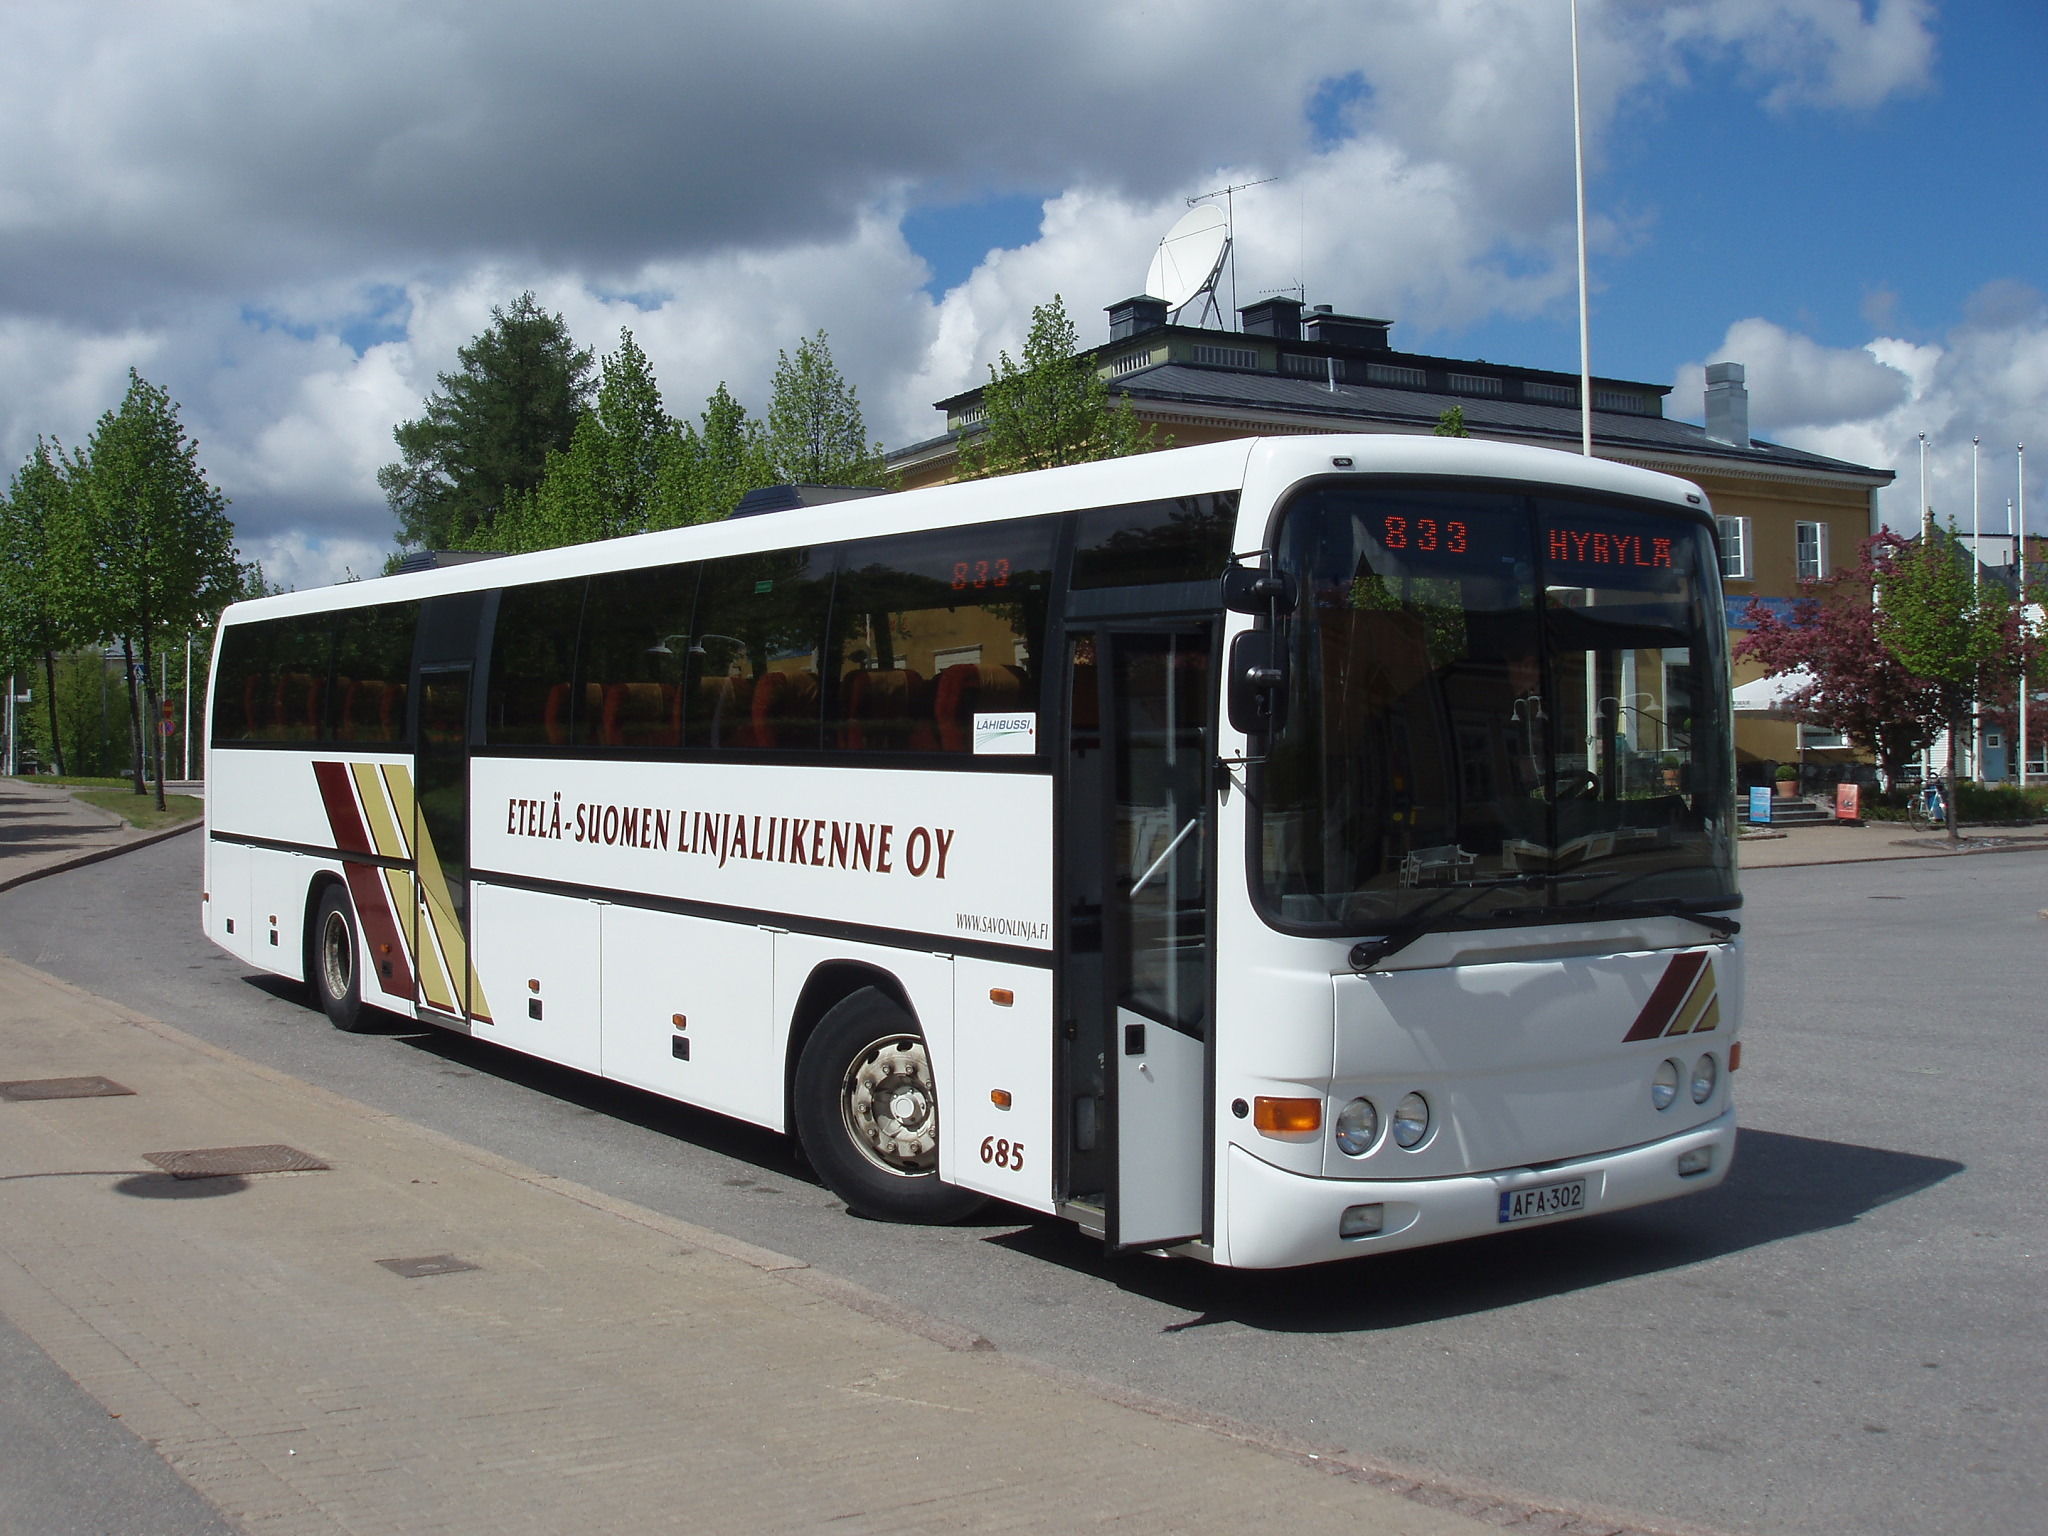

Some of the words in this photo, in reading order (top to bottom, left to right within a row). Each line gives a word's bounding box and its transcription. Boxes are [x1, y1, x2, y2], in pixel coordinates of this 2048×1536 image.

[1385, 516, 1467, 553] 833
[1549, 529, 1671, 567] HYRYLÄ
[952, 558, 1010, 590] 833
[976, 718, 1031, 731] LÄHIBUSSI
[506, 790, 672, 851] ETELÄ-SUOMEN
[676, 810, 895, 874] LINJALIIKENNE
[905, 825, 956, 880] OY
[956, 912, 1049, 941] WWW.SAVONLINJA.FI
[980, 1135, 1025, 1172] 685
[1512, 1184, 1581, 1216] AFA-302
